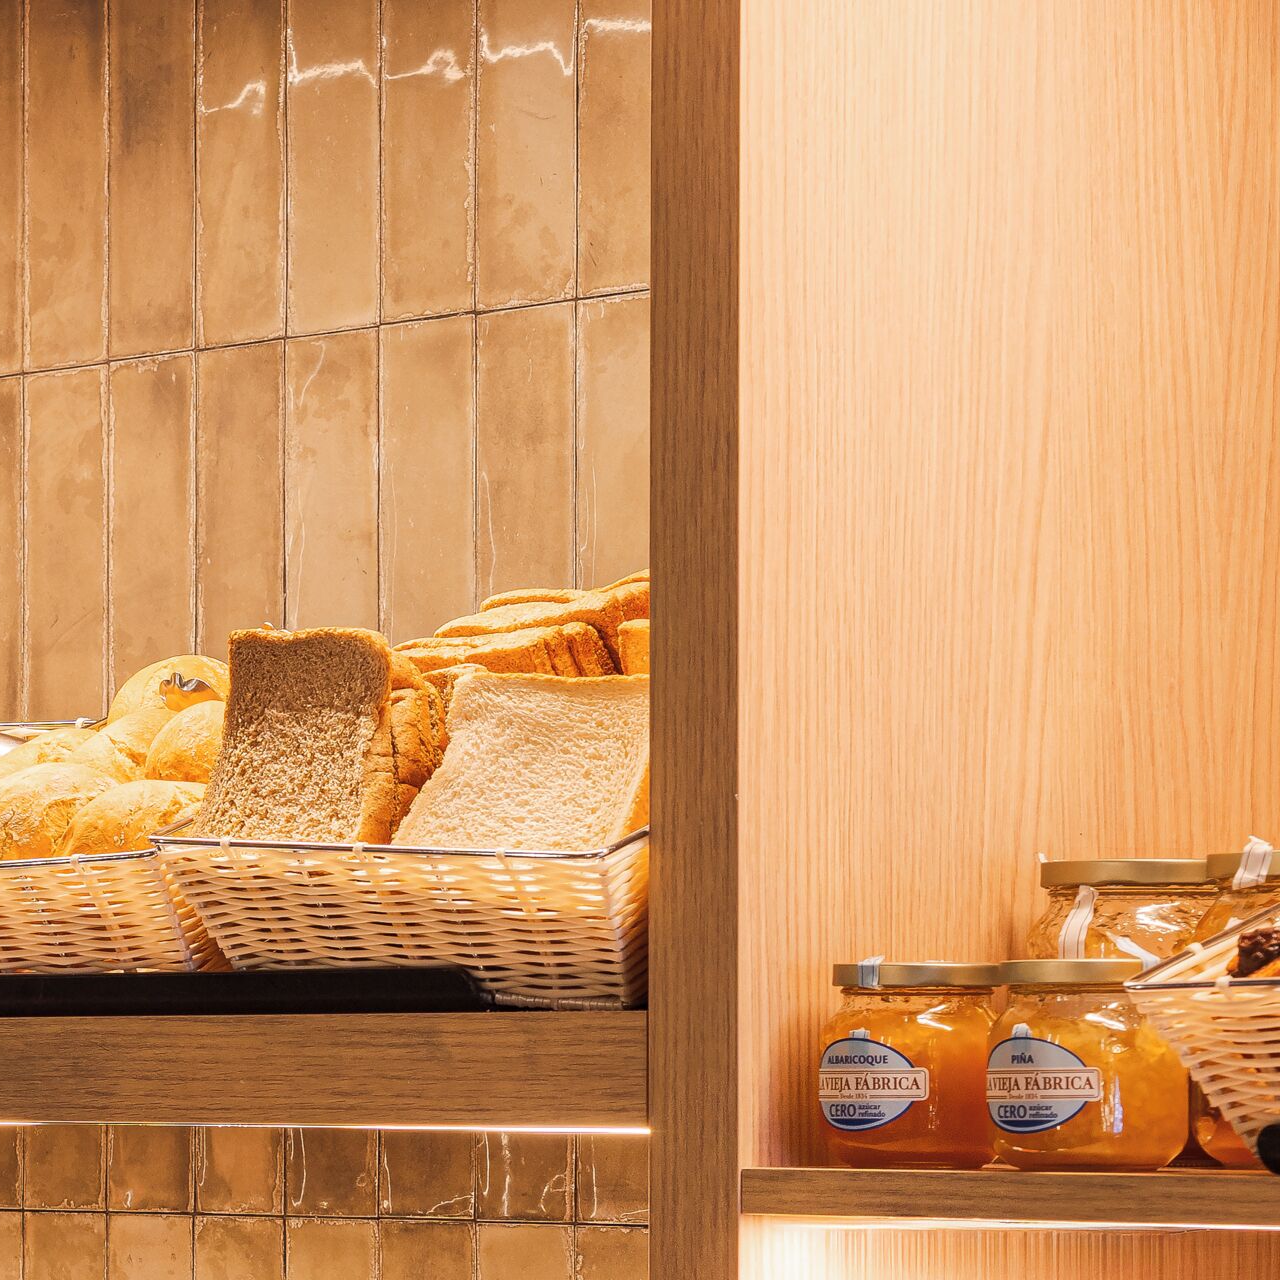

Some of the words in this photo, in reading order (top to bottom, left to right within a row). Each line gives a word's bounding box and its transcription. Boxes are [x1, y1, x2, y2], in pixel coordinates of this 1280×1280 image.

[827, 1055, 888, 1066] ALBARICOQUE
[1011, 1053, 1034, 1064] PIÑA
[825, 1077, 851, 1092] VIEJA
[855, 1073, 921, 1091] FÁBRICA
[992, 1077, 1020, 1092] VIEJA
[1024, 1073, 1094, 1091] FÁBRICA
[829, 1104, 857, 1118] CERO
[998, 1105, 1027, 1119] CERO
